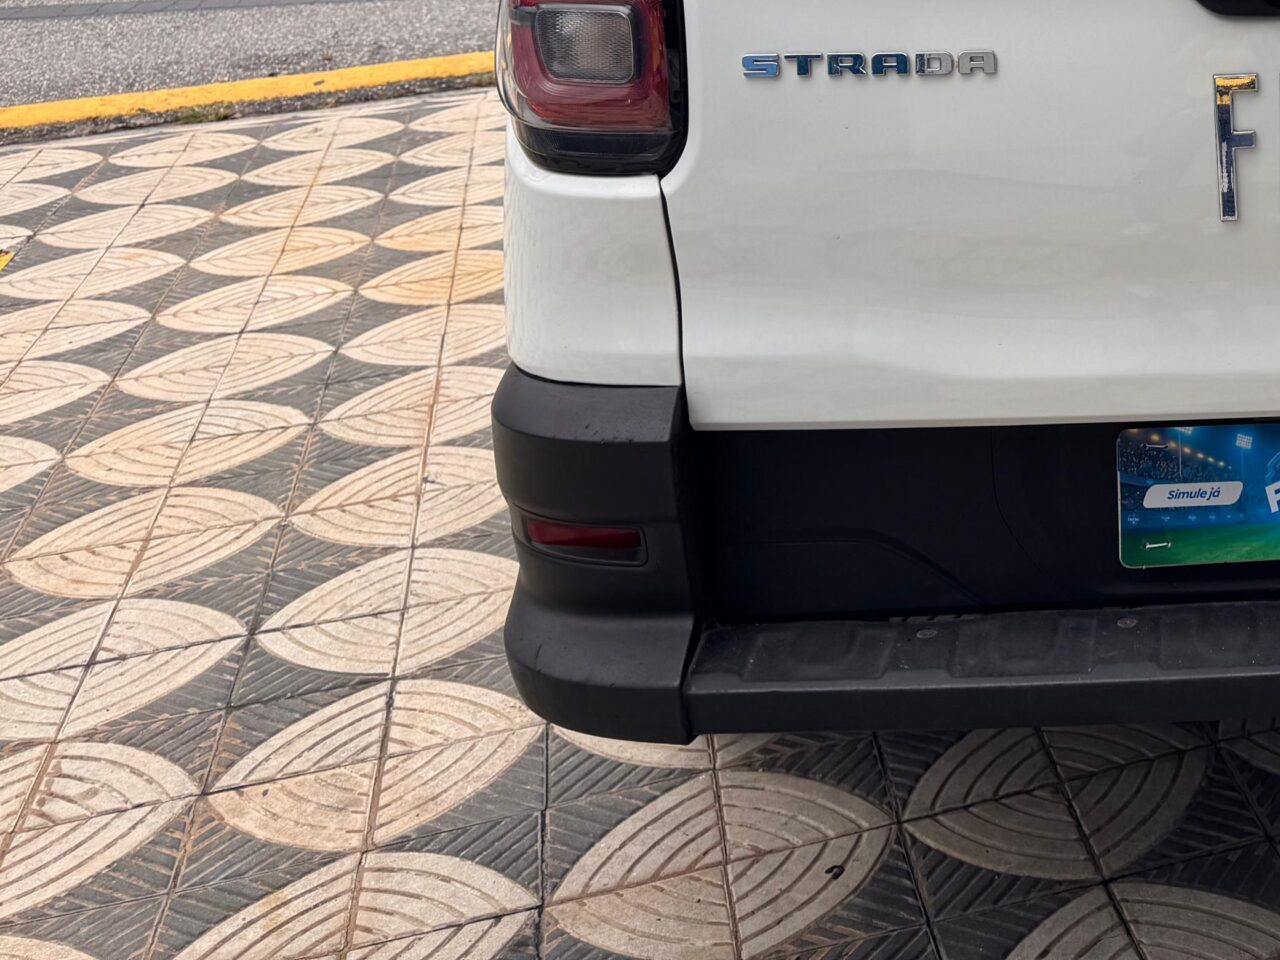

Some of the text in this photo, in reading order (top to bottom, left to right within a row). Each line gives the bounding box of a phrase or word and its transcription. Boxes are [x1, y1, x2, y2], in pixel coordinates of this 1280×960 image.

[742, 50, 998, 77] STRADA
[1167, 487, 1221, 501] Simule já
